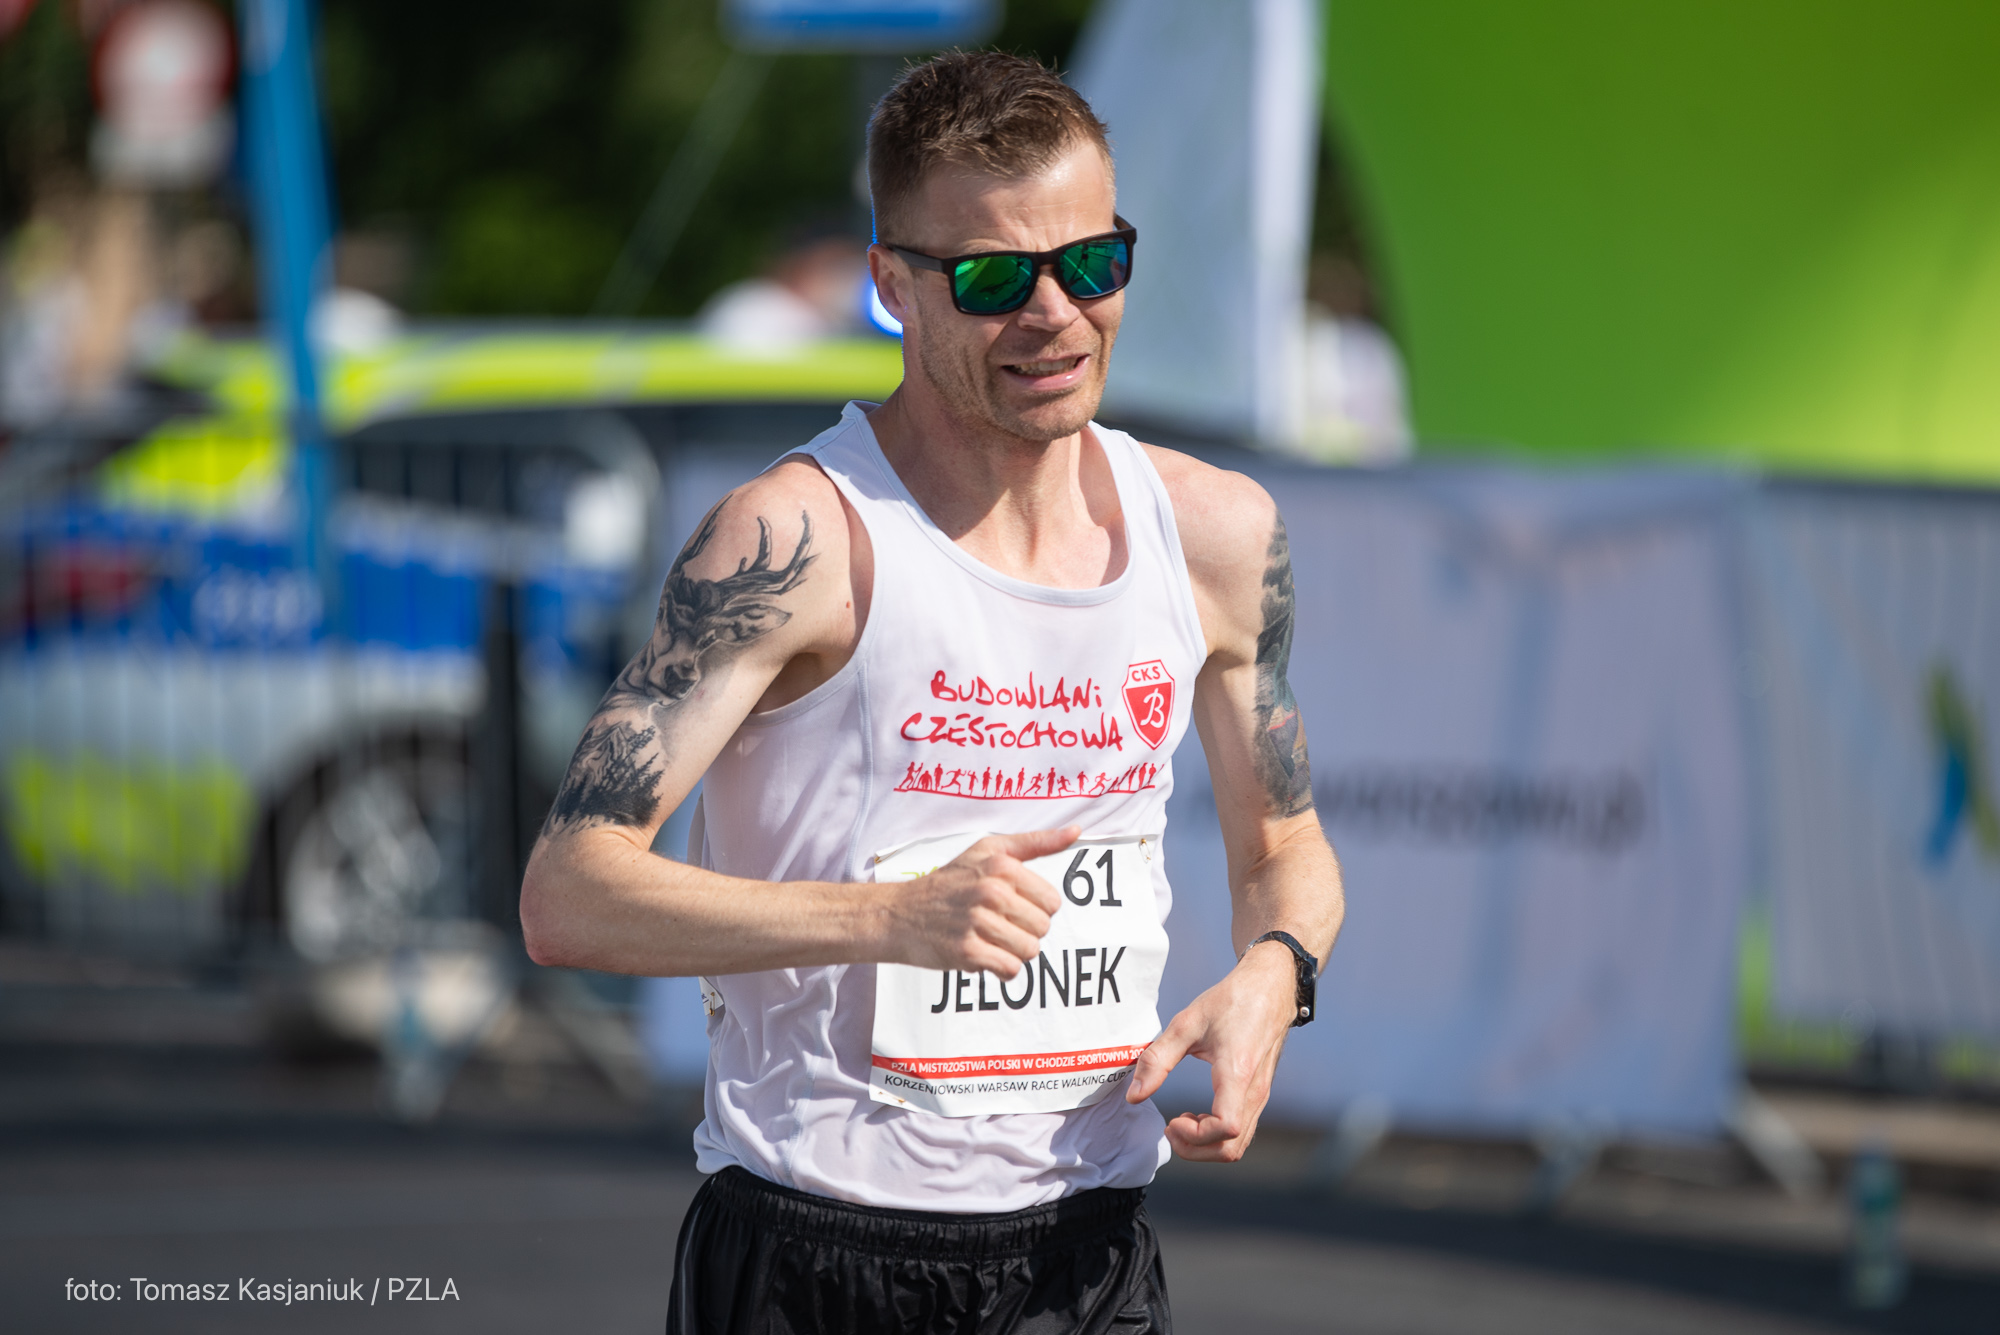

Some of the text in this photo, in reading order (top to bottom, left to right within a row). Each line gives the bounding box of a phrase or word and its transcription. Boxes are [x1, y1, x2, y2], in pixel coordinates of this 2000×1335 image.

[1131, 666, 1161, 682] CKS
[1140, 687, 1165, 729] B
[1063, 849, 1123, 907] 61
[891, 1061, 917, 1073] PZLA
[918, 1060, 987, 1074] MISTRZOSTWA
[987, 1058, 1021, 1070] POLSKI
[1022, 1058, 1034, 1069] W
[1035, 1055, 1076, 1069] CHODZIE
[1076, 1050, 1129, 1066] SPORTOWYM
[884, 1074, 975, 1096] KORZENIOWSKI
[977, 1081, 1029, 1093] WARSAW
[1031, 1079, 1060, 1091] RACE
[1061, 1074, 1106, 1089] WALKING
